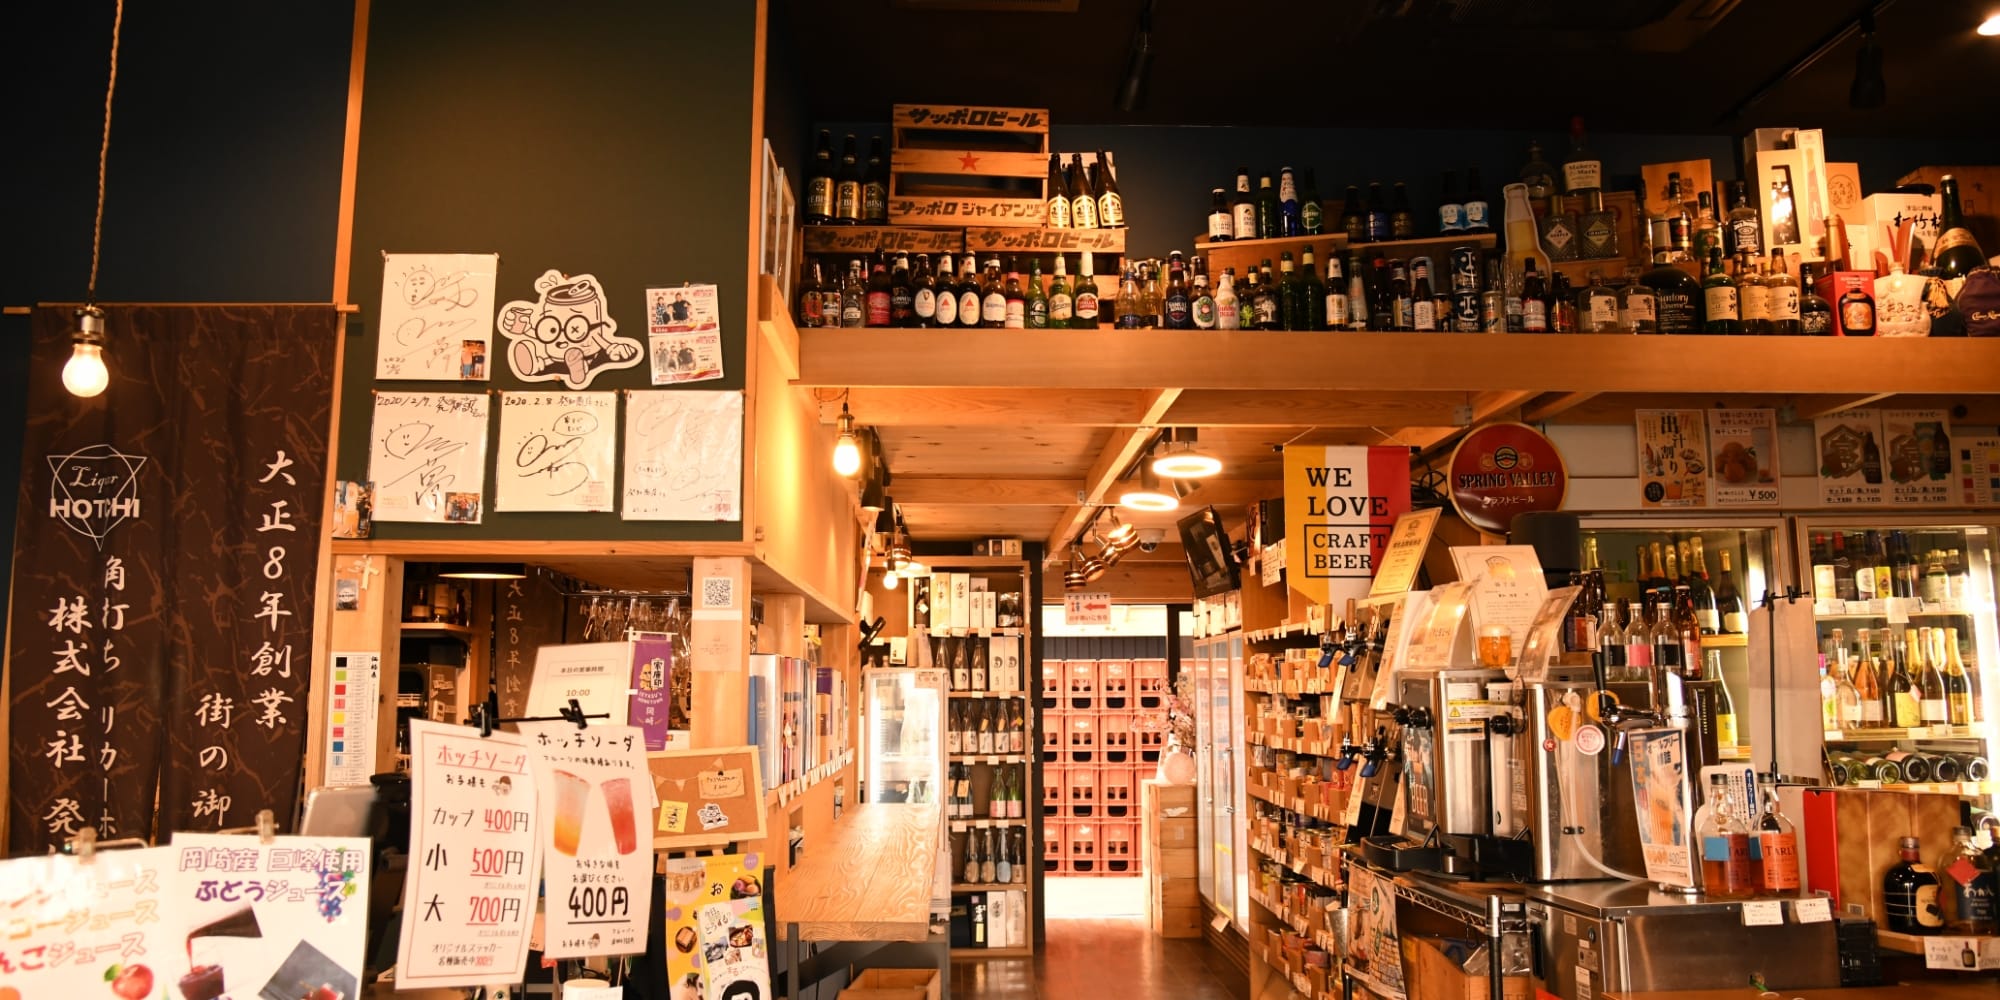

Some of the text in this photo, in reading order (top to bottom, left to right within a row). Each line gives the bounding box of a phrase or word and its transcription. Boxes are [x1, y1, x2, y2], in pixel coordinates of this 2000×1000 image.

[908, 107, 1042, 128] サッポロビール
[897, 200, 957, 215] サッポロ
[980, 229, 1115, 249] サッポロビール
[1660, 415, 1686, 475] 出汁割り
[1305, 467, 1352, 487] WE
[1458, 471, 1556, 489] SPRING VALLEY
[1306, 495, 1389, 516] LOVE
[1483, 494, 1535, 507] クラフトビール
[1313, 533, 1387, 549] CRAFT
[1314, 554, 1373, 569] BEER
[250, 449, 297, 730] 大正8年創業
[45, 595, 94, 769] 株式会社
[565, 688, 591, 697] 10:00
[537, 731, 635, 752] ホッチソーダ
[433, 807, 529, 833] カップ 400円
[179, 846, 365, 874] 岡崎産 巨峰使用
[426, 843, 524, 876] 小 500円
[195, 879, 348, 903] ぶどうジュース
[424, 894, 521, 923] 大 700円
[569, 886, 629, 919] 400円
